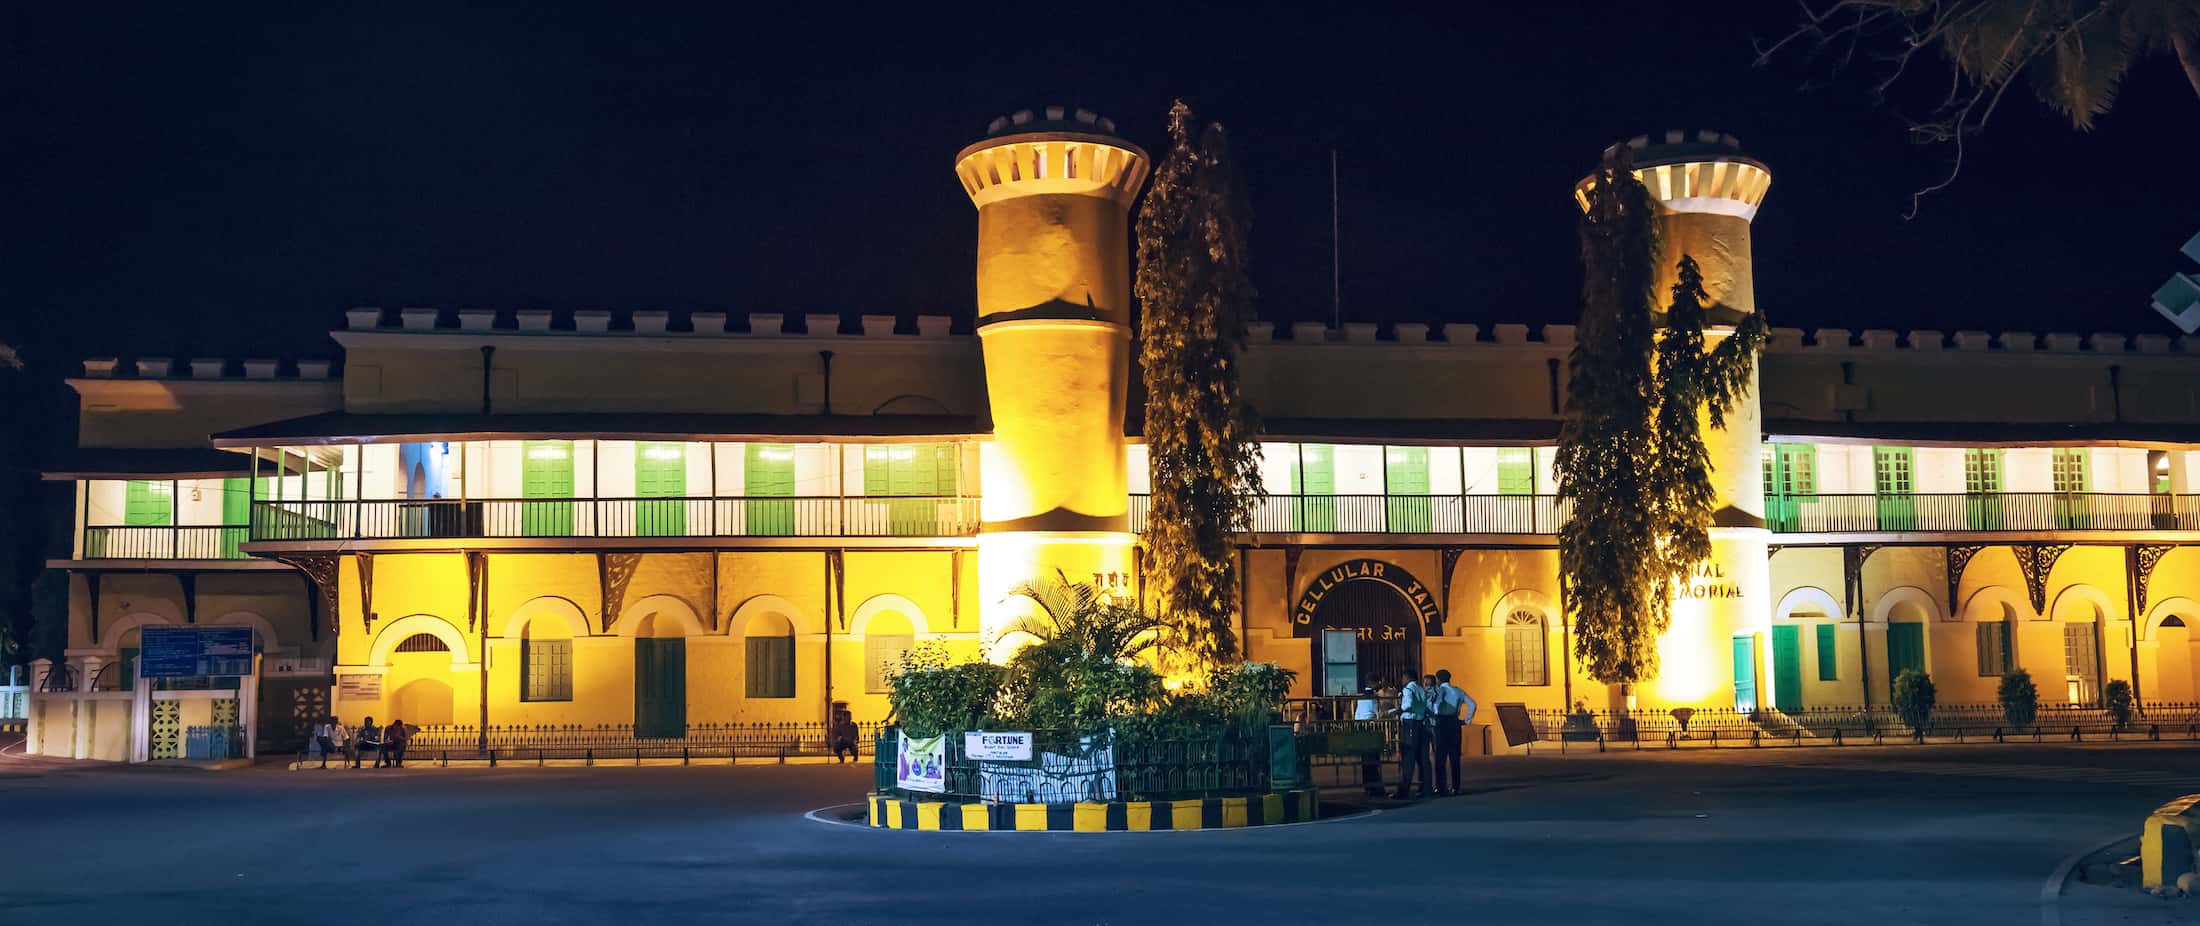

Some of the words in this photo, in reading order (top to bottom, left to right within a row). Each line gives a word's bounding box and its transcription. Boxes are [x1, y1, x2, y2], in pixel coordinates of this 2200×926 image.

[1297, 562, 1385, 625] CELLULAR
[1407, 580, 1438, 624] JAIL
[1381, 624, 1407, 641] जेल
[982, 735, 1024, 745] FORTUNE
